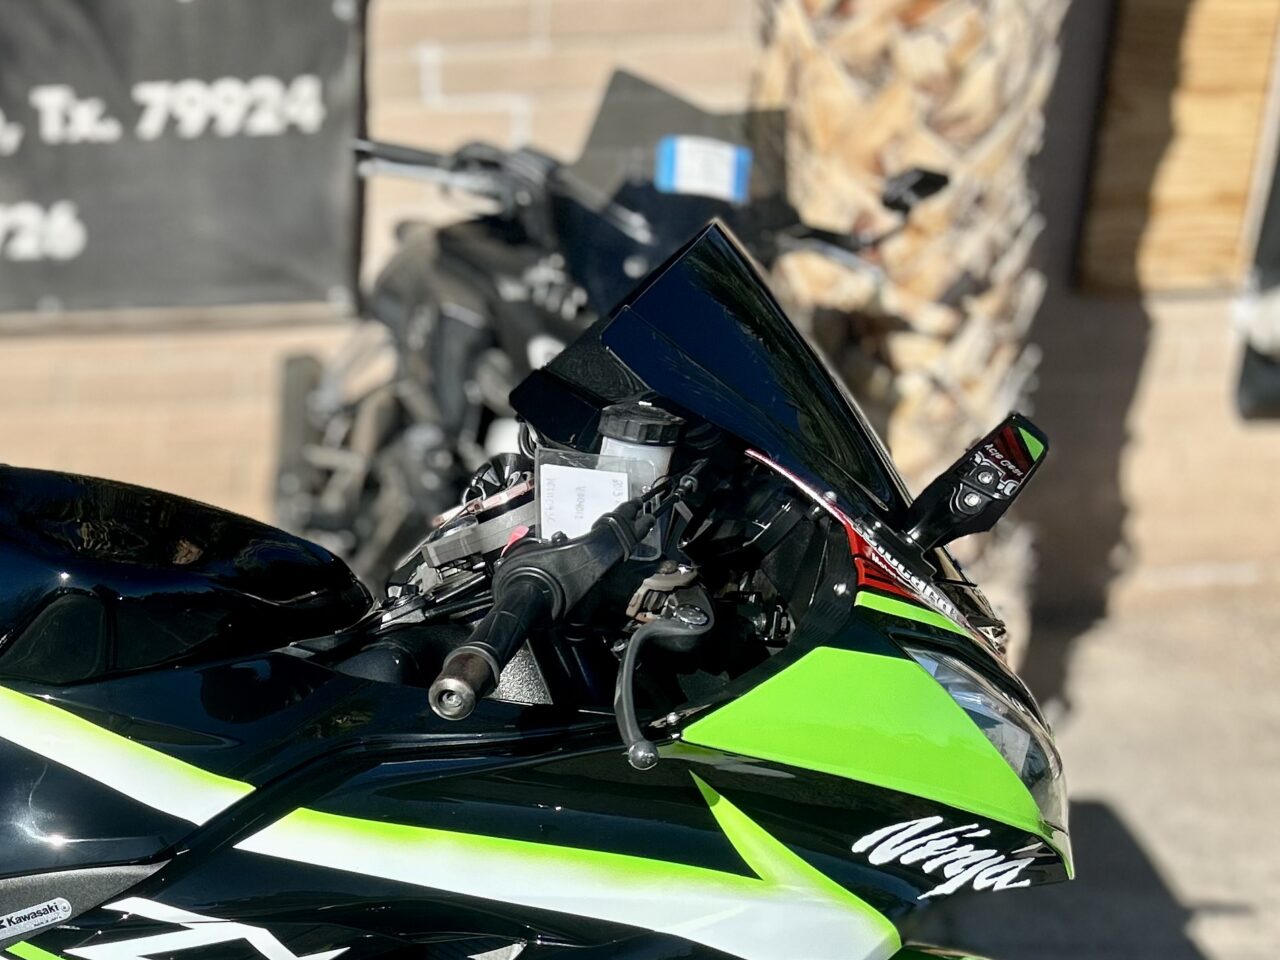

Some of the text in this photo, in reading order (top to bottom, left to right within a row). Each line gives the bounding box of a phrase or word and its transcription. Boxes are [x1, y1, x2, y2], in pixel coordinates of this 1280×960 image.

[28, 83, 122, 144] Tx.
[131, 74, 324, 140] 79924
[851, 815, 1036, 900] Ninja
[6, 902, 60, 927] Kawasaki
